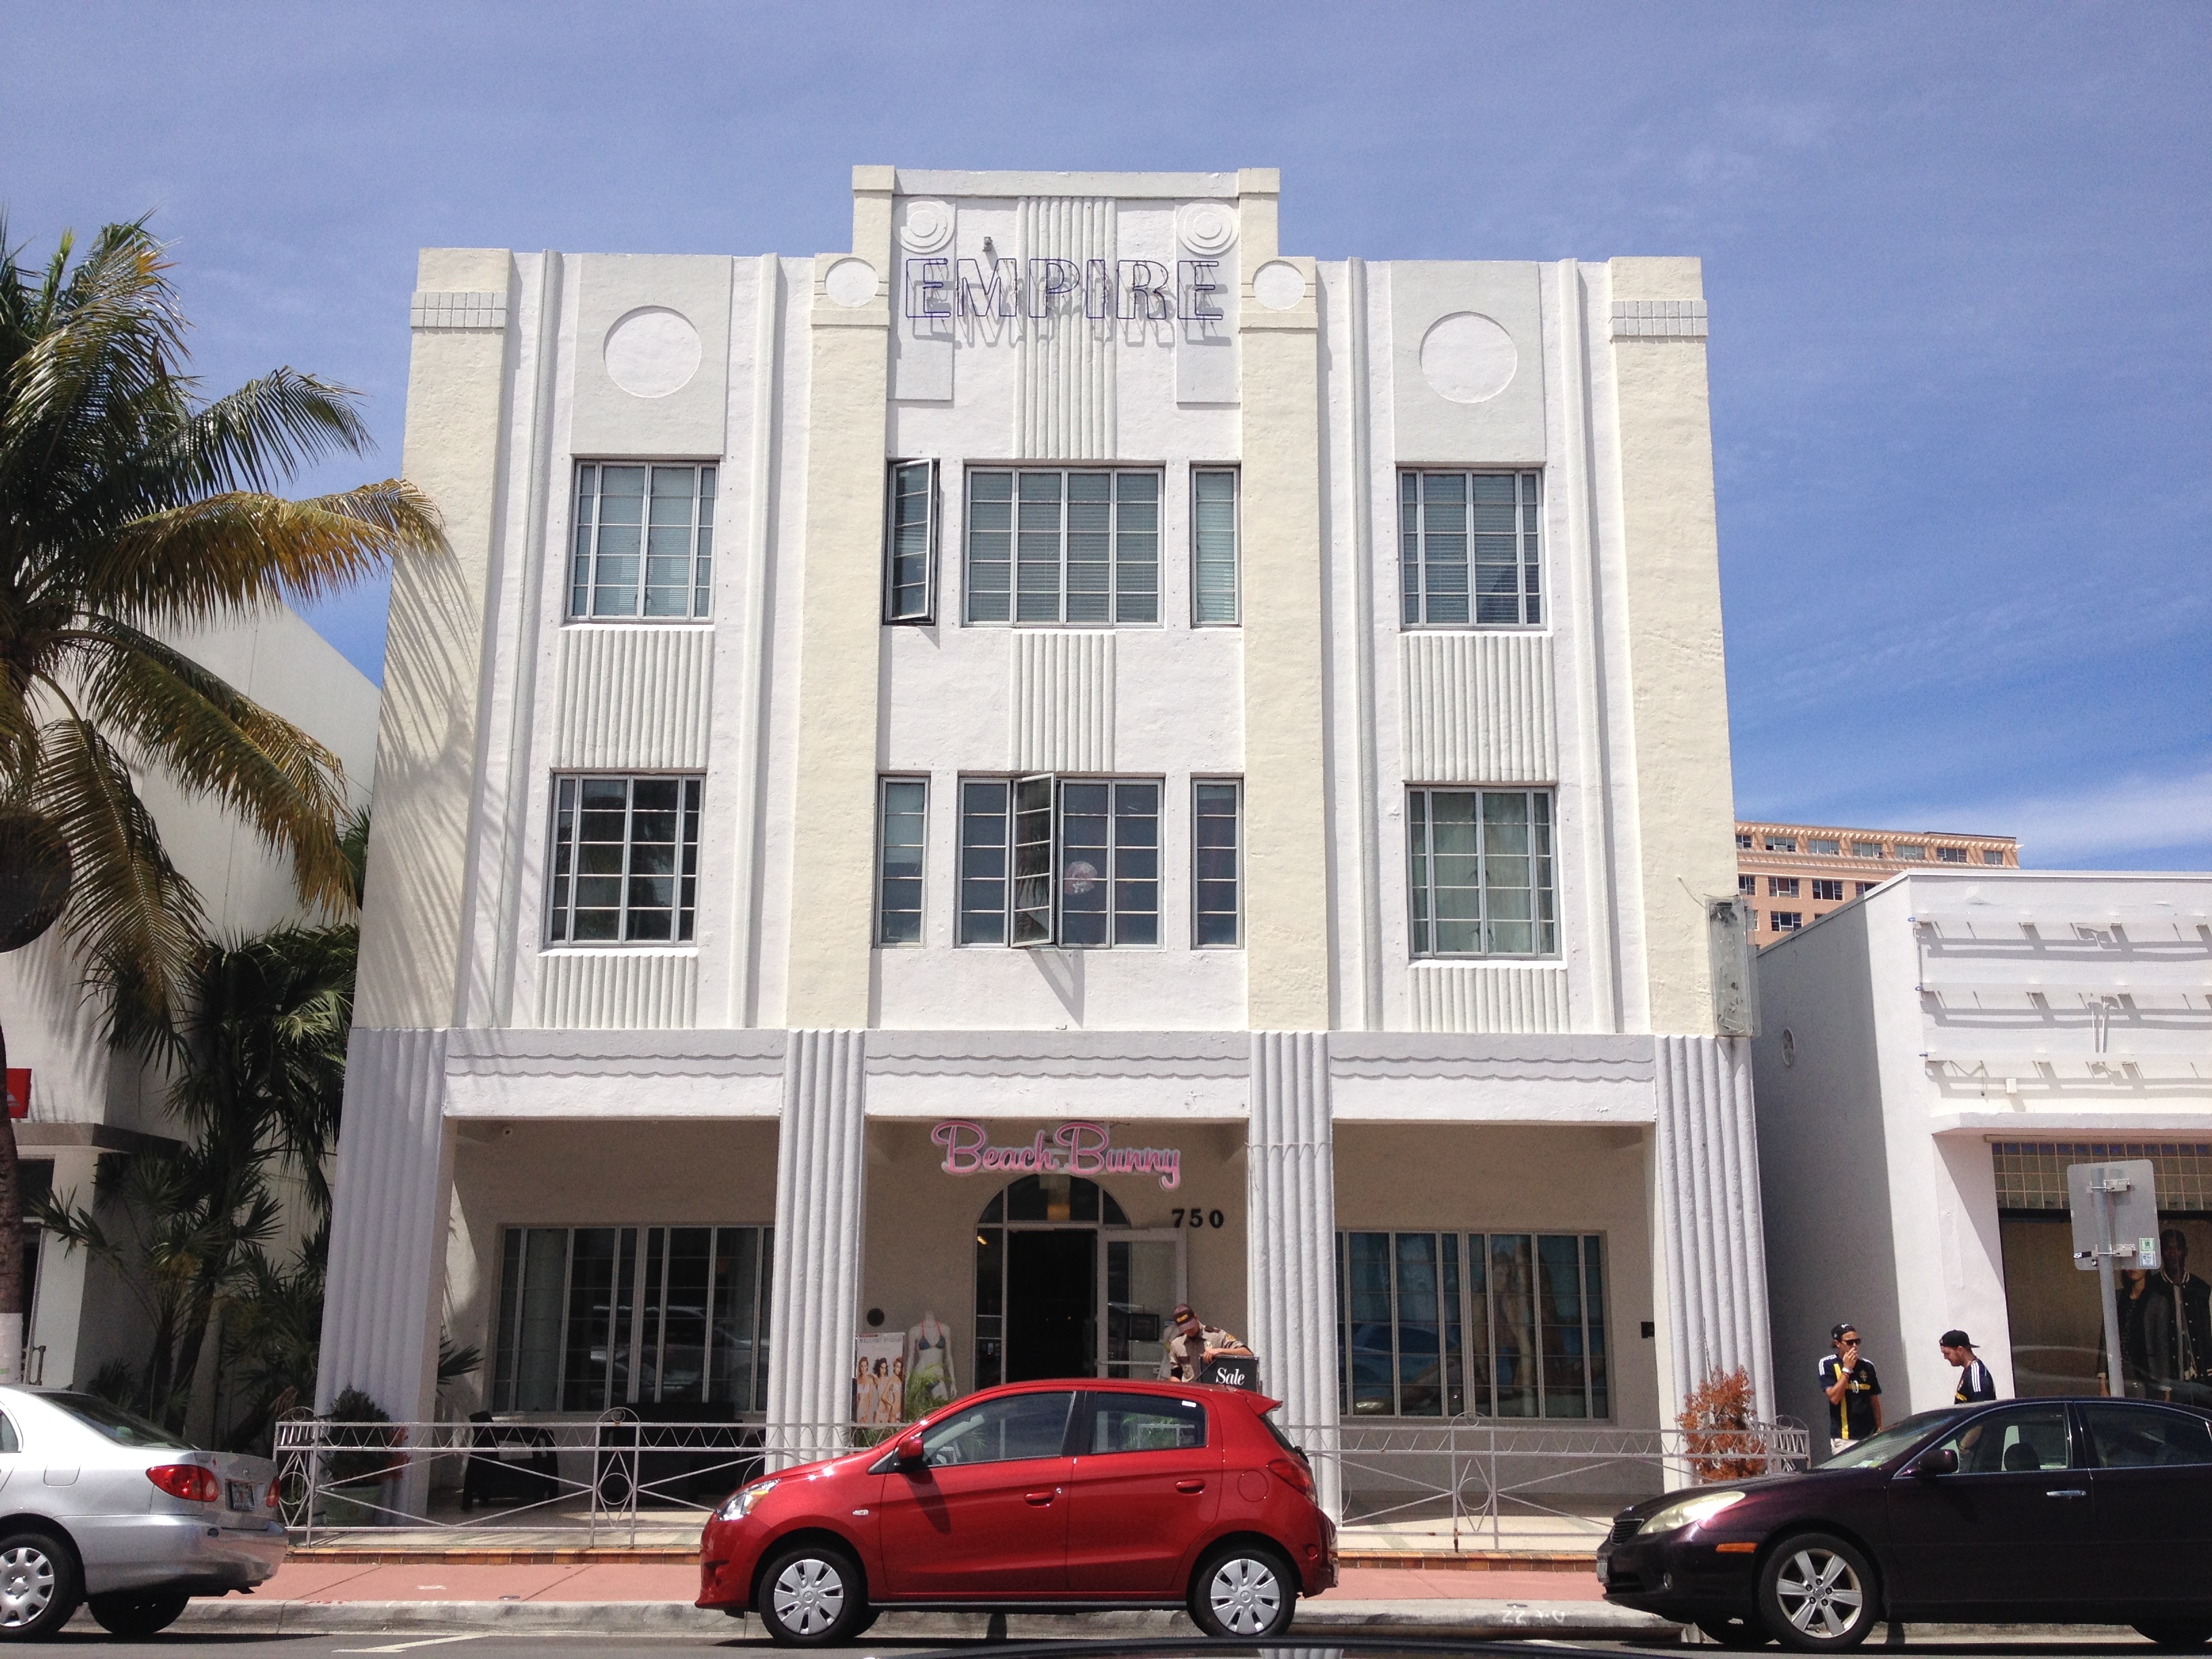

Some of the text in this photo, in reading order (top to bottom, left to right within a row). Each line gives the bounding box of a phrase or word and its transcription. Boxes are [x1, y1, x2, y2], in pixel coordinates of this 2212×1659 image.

[905, 258, 1223, 321] EMPIRE
[930, 1121, 1181, 1191] Beach Bunny
[1171, 1208, 1225, 1229] 750
[1215, 1367, 1246, 1386] Sale
